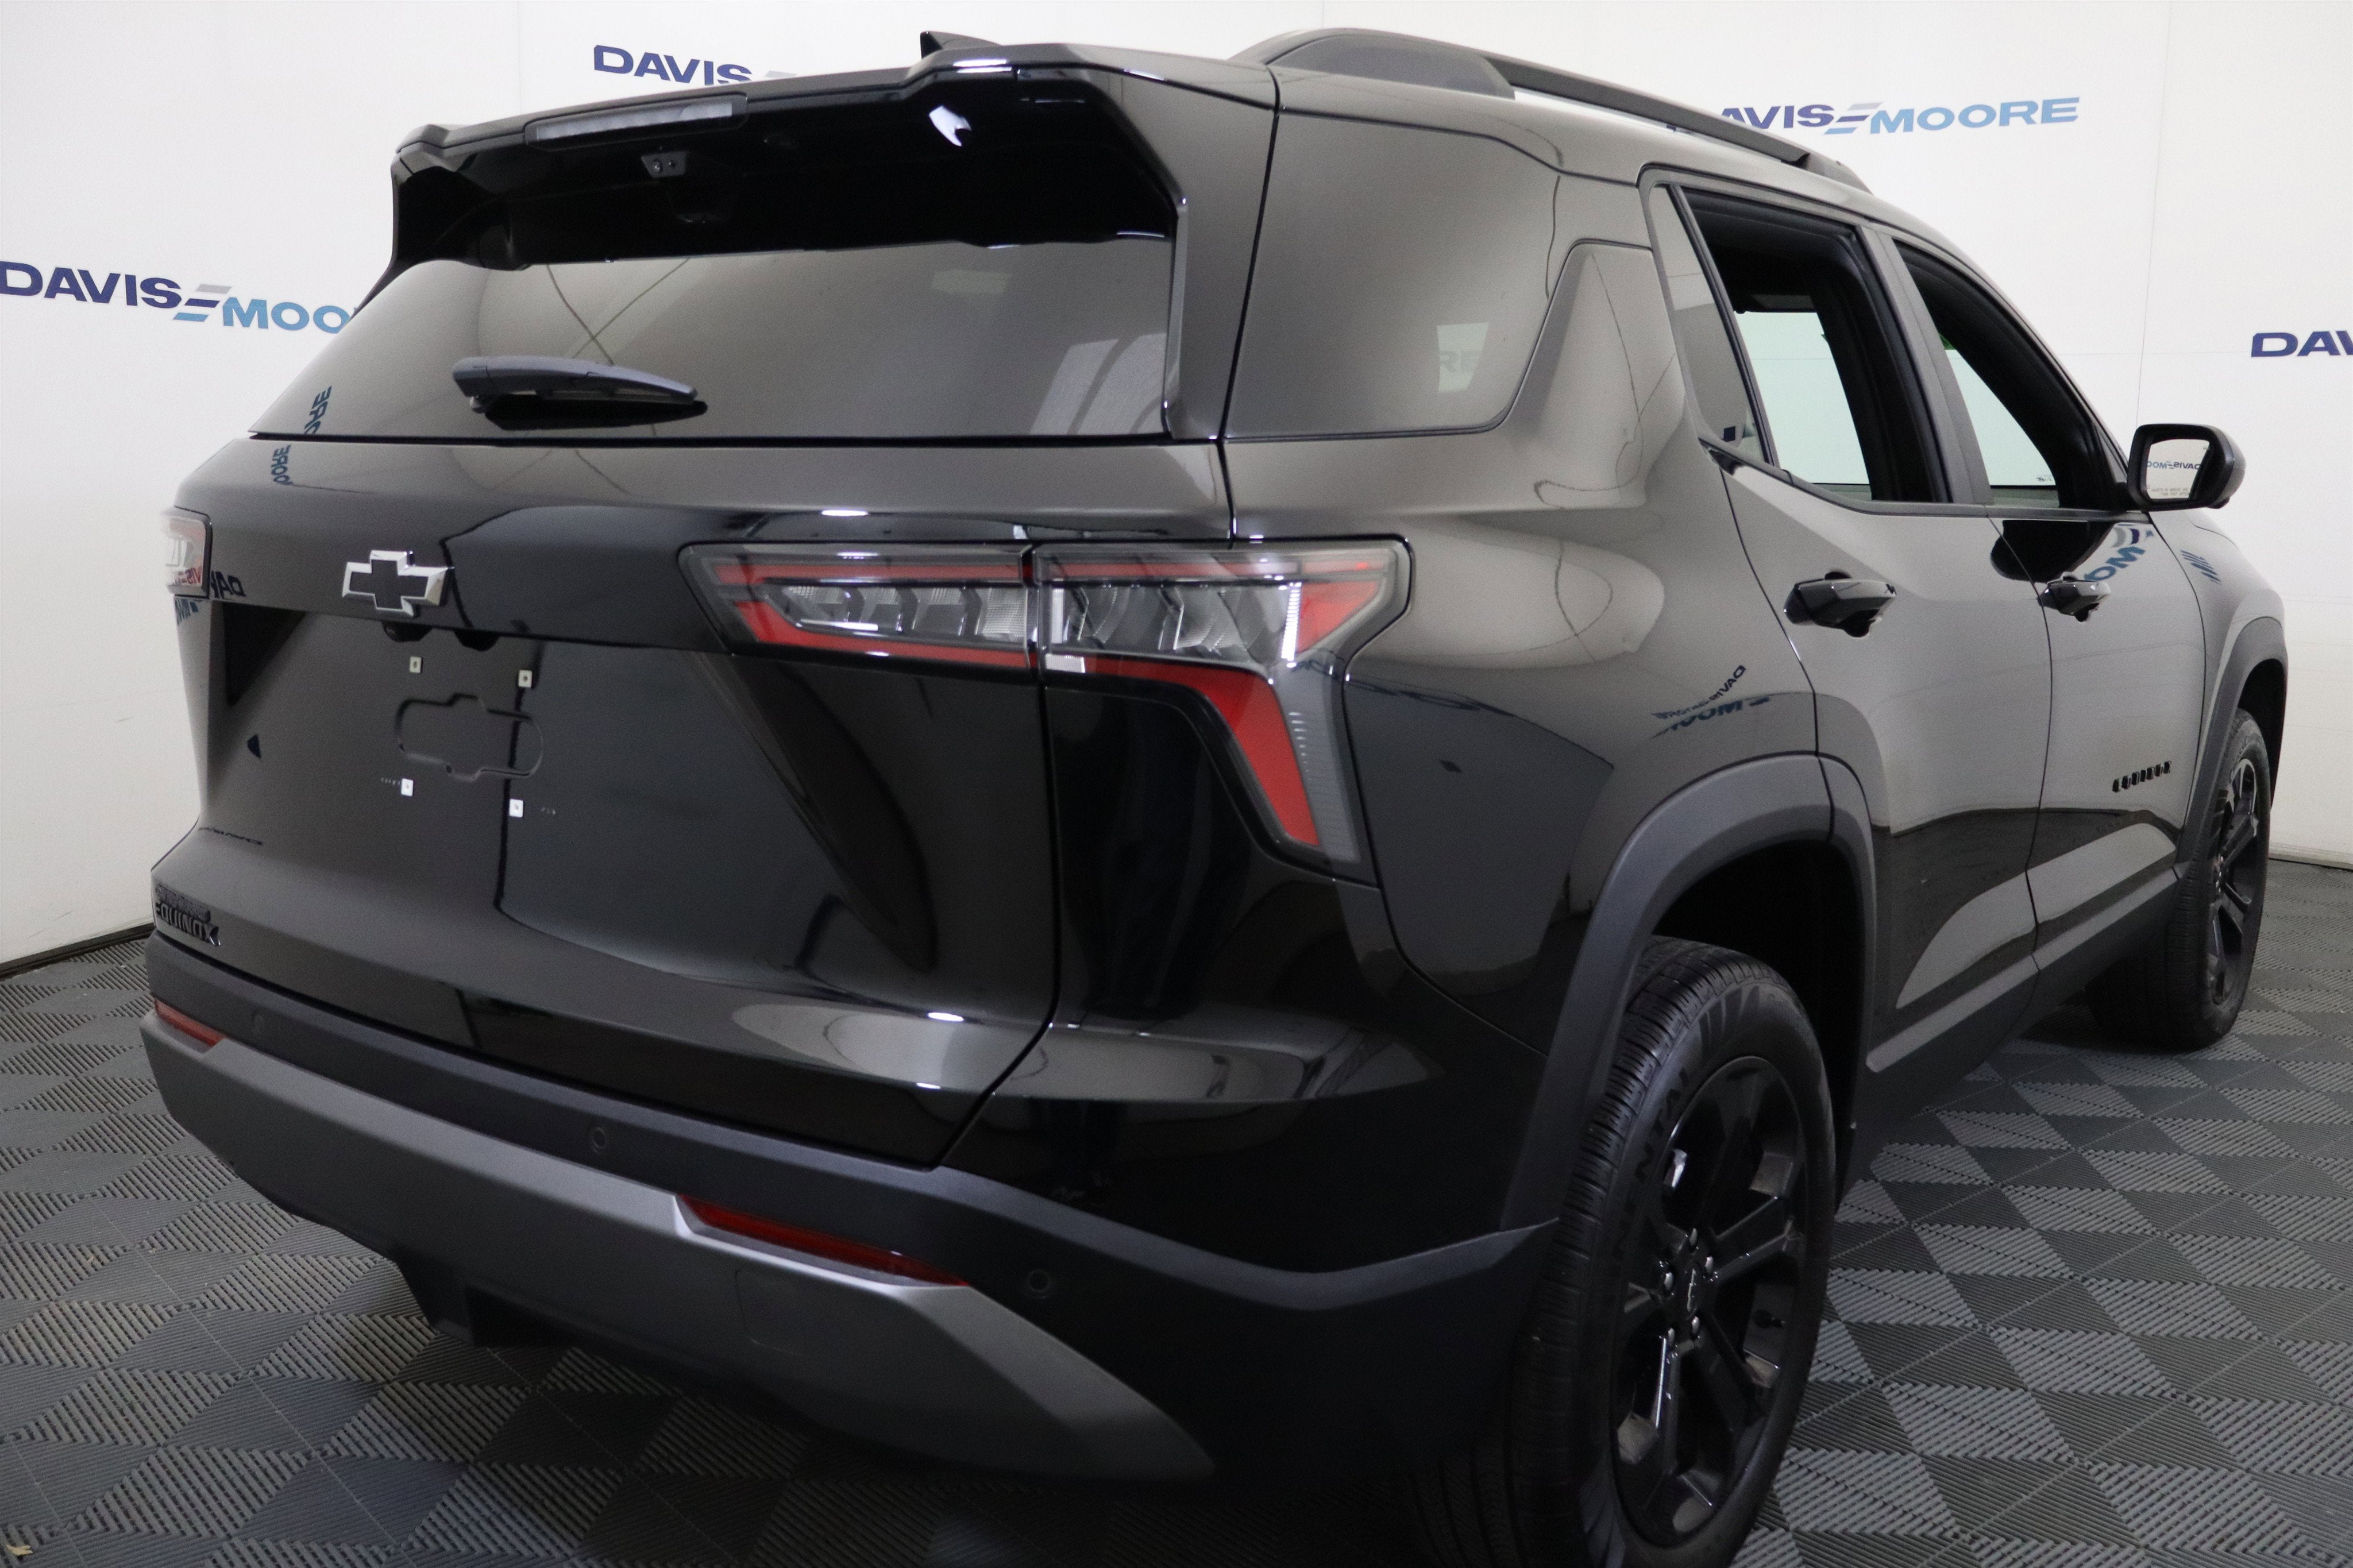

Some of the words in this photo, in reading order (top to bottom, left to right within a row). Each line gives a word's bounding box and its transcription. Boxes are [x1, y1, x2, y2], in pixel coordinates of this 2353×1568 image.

[594, 45, 753, 86] DAVIS
[1722, 104, 1835, 130] AVIS
[1870, 97, 2080, 134] MOORE
[0, 261, 182, 308] DAVIS
[223, 297, 352, 334] MOO
